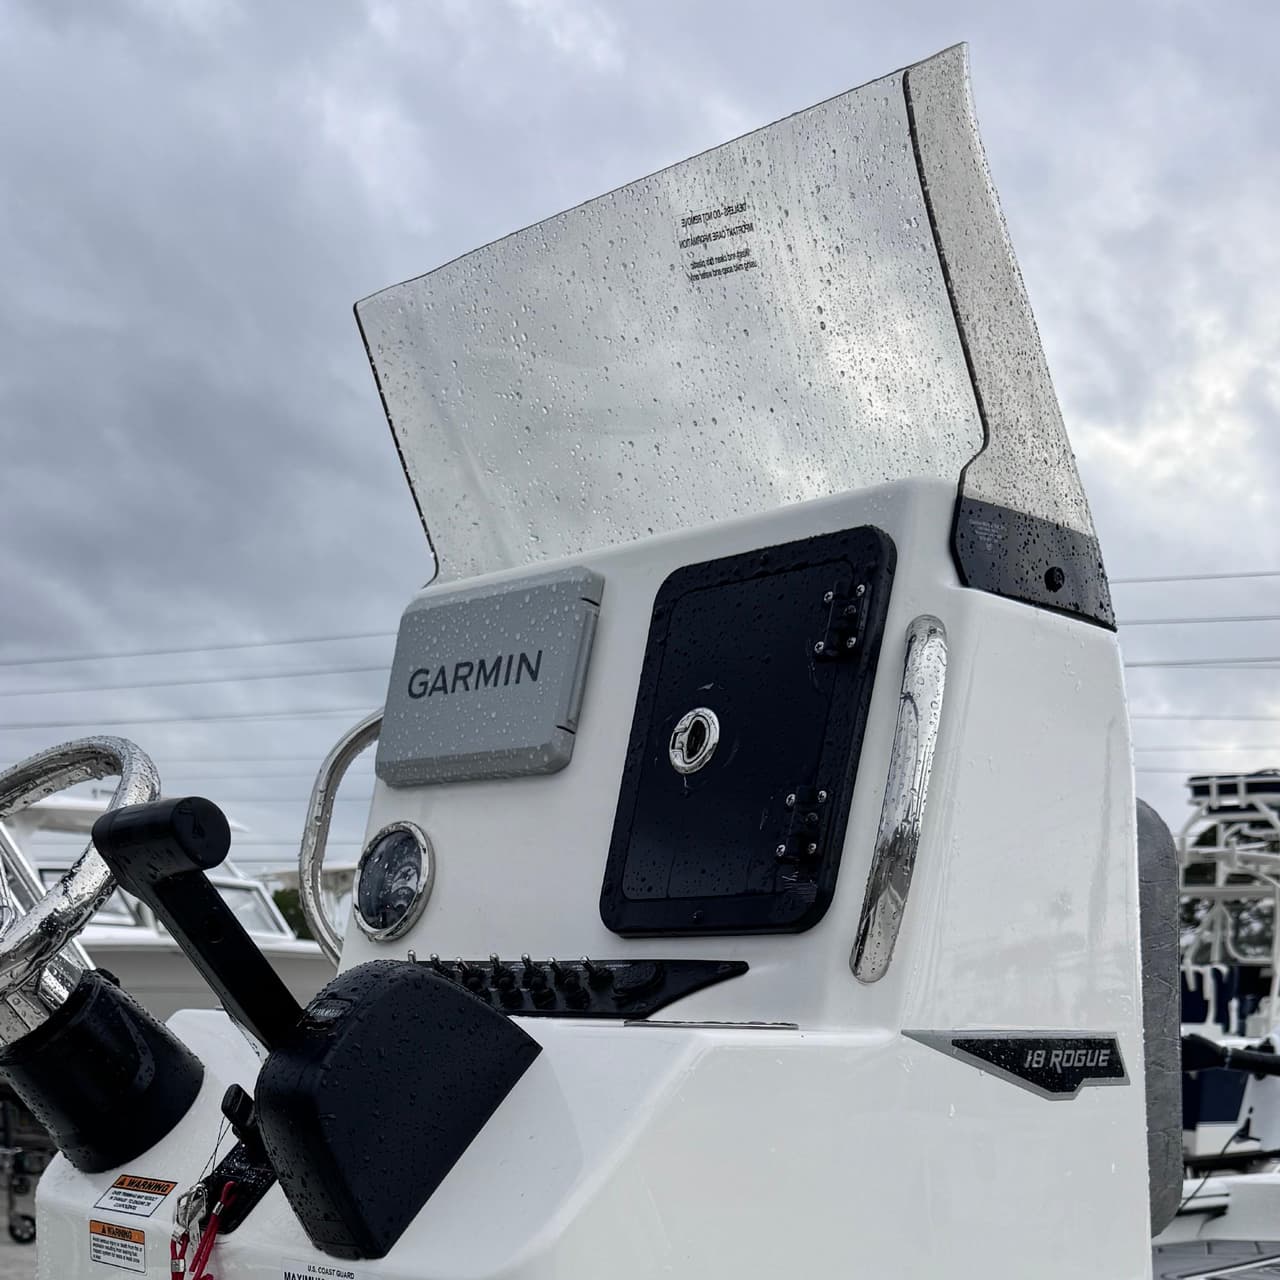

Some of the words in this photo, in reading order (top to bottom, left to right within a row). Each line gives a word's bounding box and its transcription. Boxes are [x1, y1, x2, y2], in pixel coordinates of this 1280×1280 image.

[407, 650, 543, 699] GARMIN
[1024, 1050, 1044, 1068] 18
[1049, 1049, 1111, 1074] ROGUE
[128, 1179, 170, 1192] WARNING
[107, 1226, 132, 1240] WARNING
[318, 1267, 335, 1276] COAST
[336, 1270, 354, 1280] GUARD
